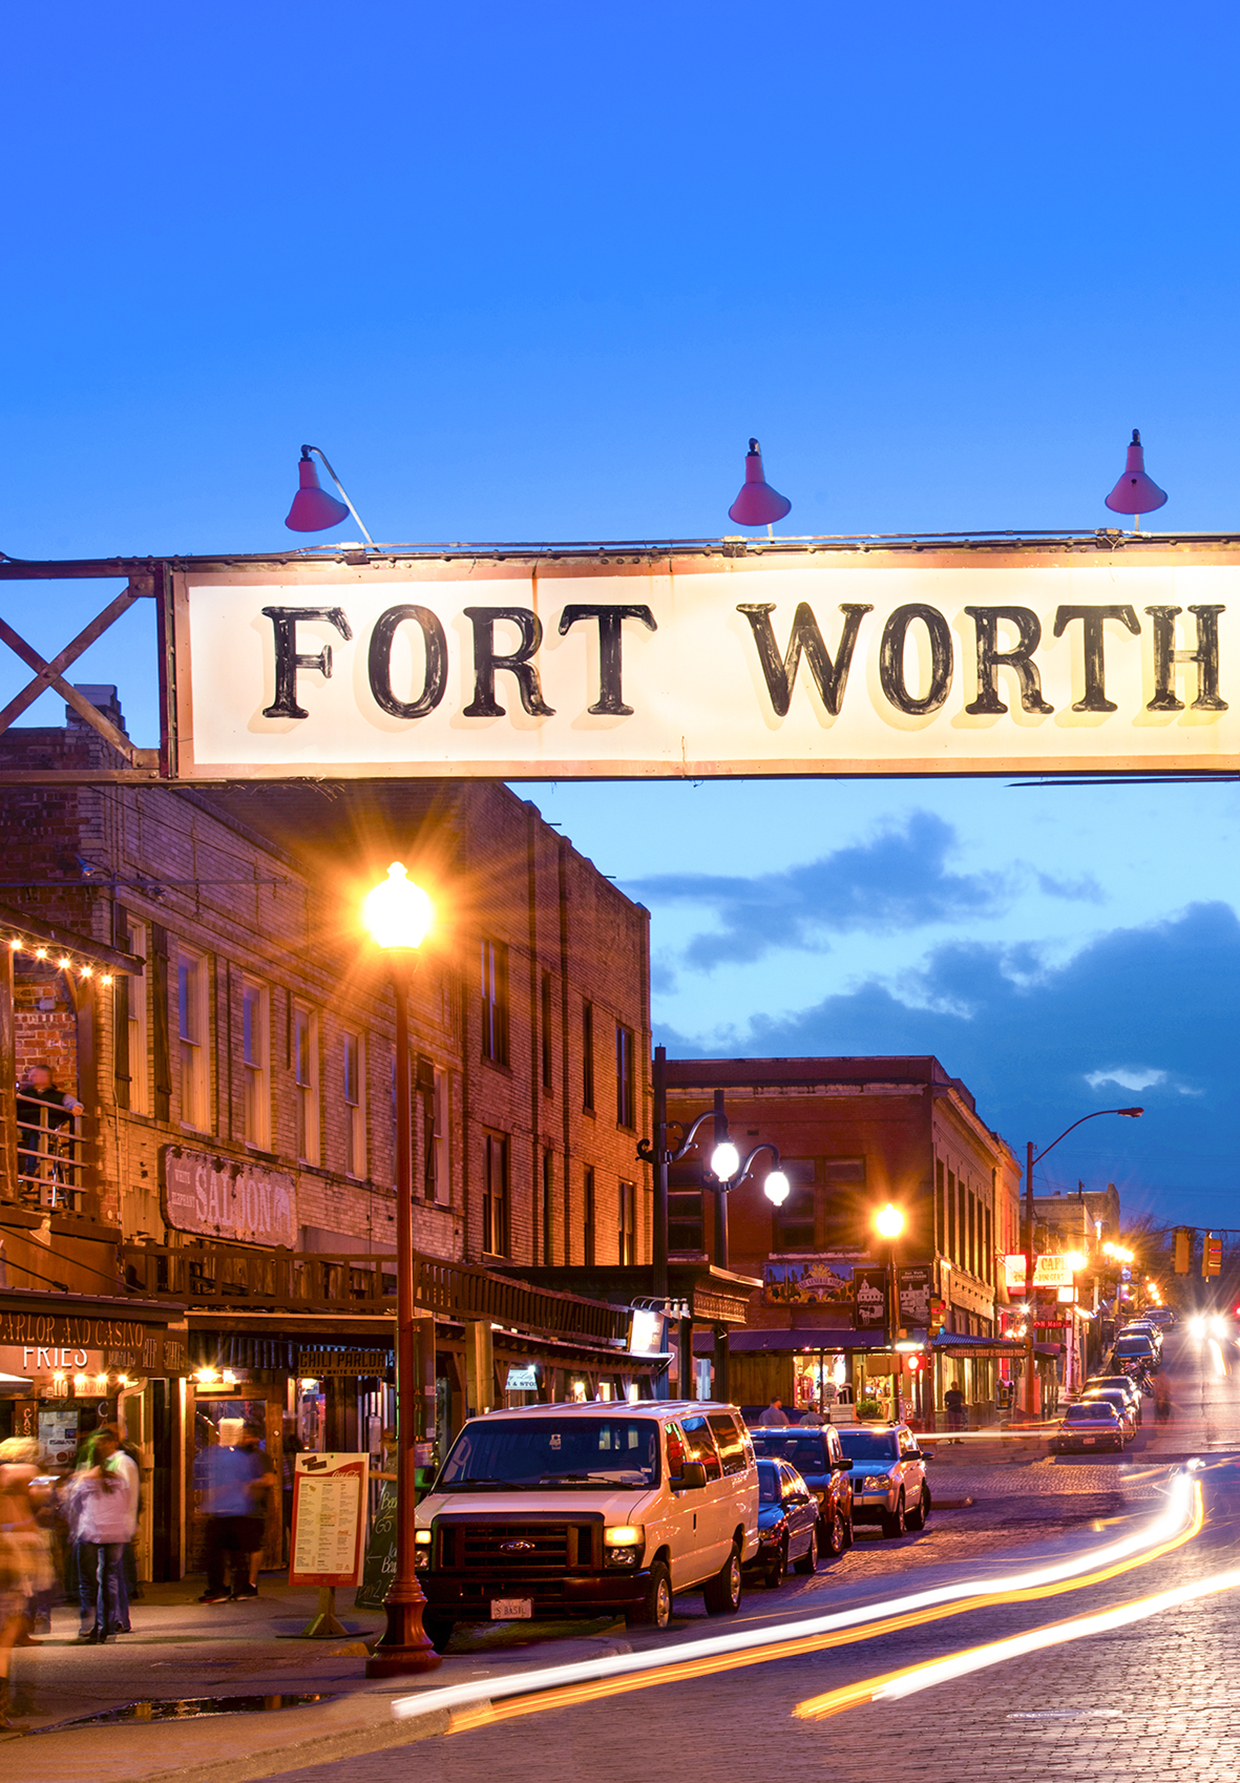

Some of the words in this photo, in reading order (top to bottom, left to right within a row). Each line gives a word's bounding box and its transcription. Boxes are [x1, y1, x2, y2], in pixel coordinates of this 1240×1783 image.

[261, 604, 658, 719] FORT
[736, 601, 1229, 716] WORTH
[195, 1165, 272, 1232] SALOON
[0, 1312, 55, 1344] ARLOR
[61, 1317, 91, 1345] AND
[95, 1320, 144, 1348] CASINO
[23, 1346, 88, 1368] FRIES
[300, 1353, 332, 1368] CHILI
[337, 1353, 385, 1368] PARLOR
